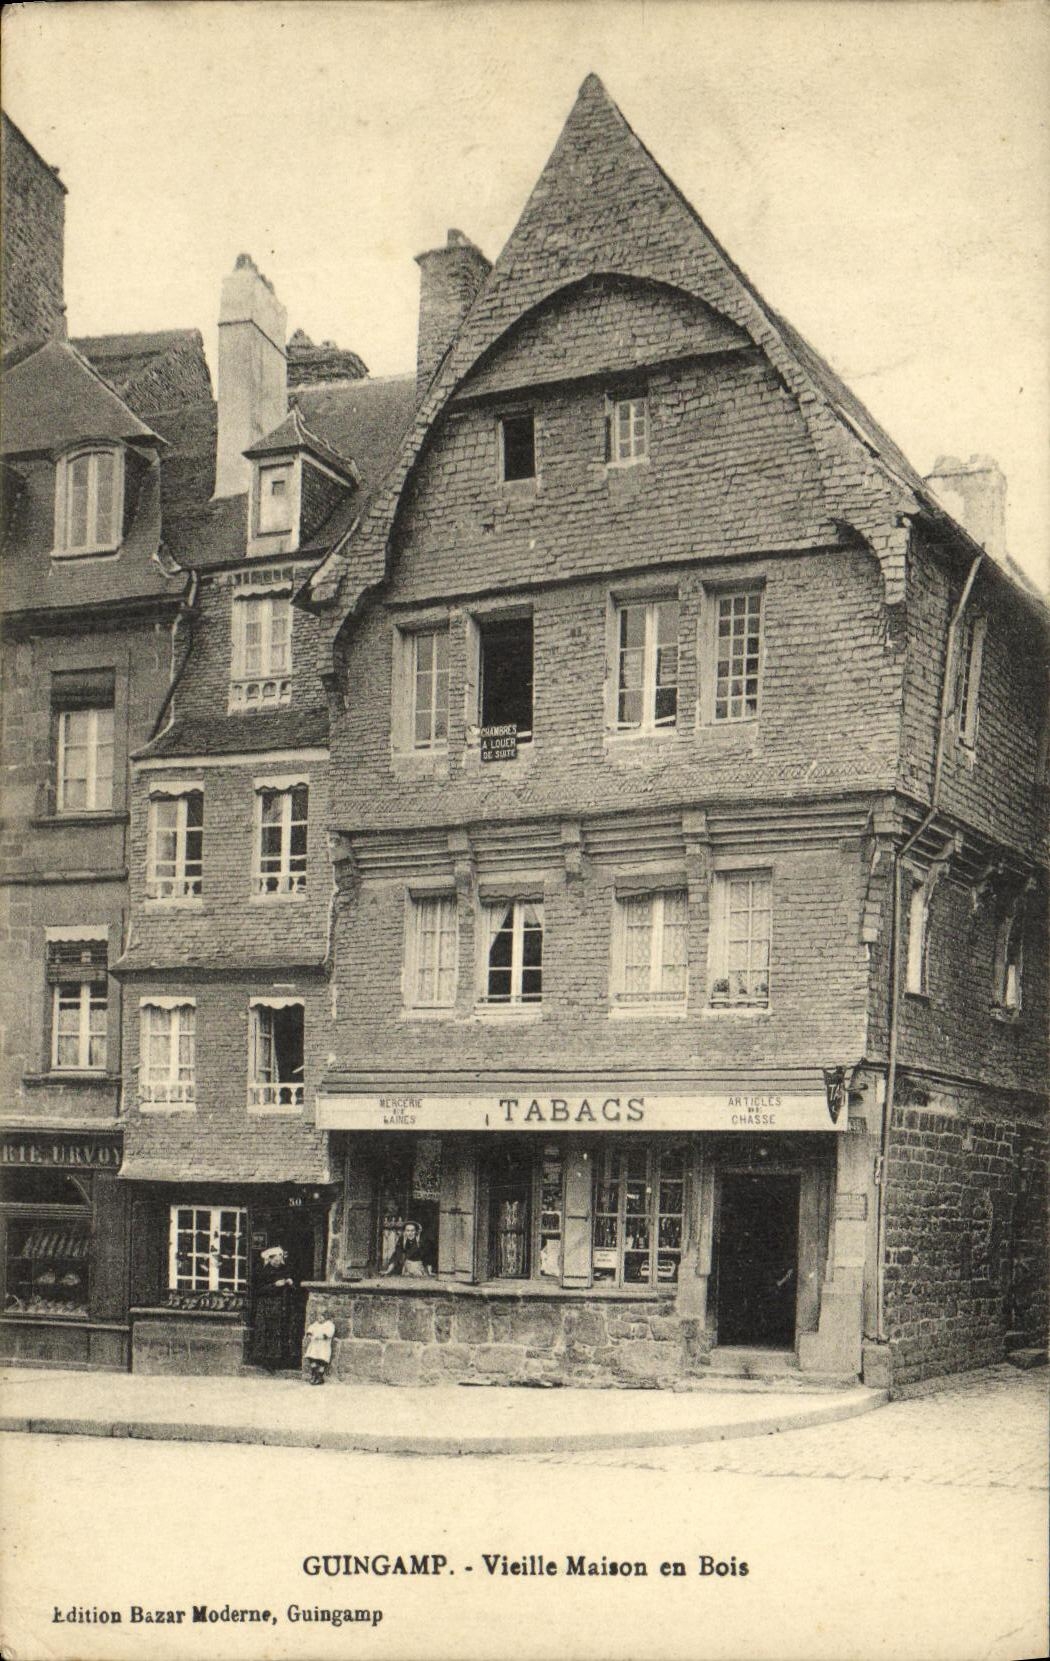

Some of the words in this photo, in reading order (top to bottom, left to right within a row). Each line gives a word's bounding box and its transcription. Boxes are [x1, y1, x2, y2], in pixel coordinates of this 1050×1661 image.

[481, 725, 517, 737] CHAMBRES
[482, 741, 488, 749] A
[491, 738, 516, 749] LOUER
[483, 751, 492, 759] DE
[728, 1096, 782, 1107] ARTICLES
[499, 1098, 645, 1122] TABACS
[731, 1114, 776, 1124] CHASSE
